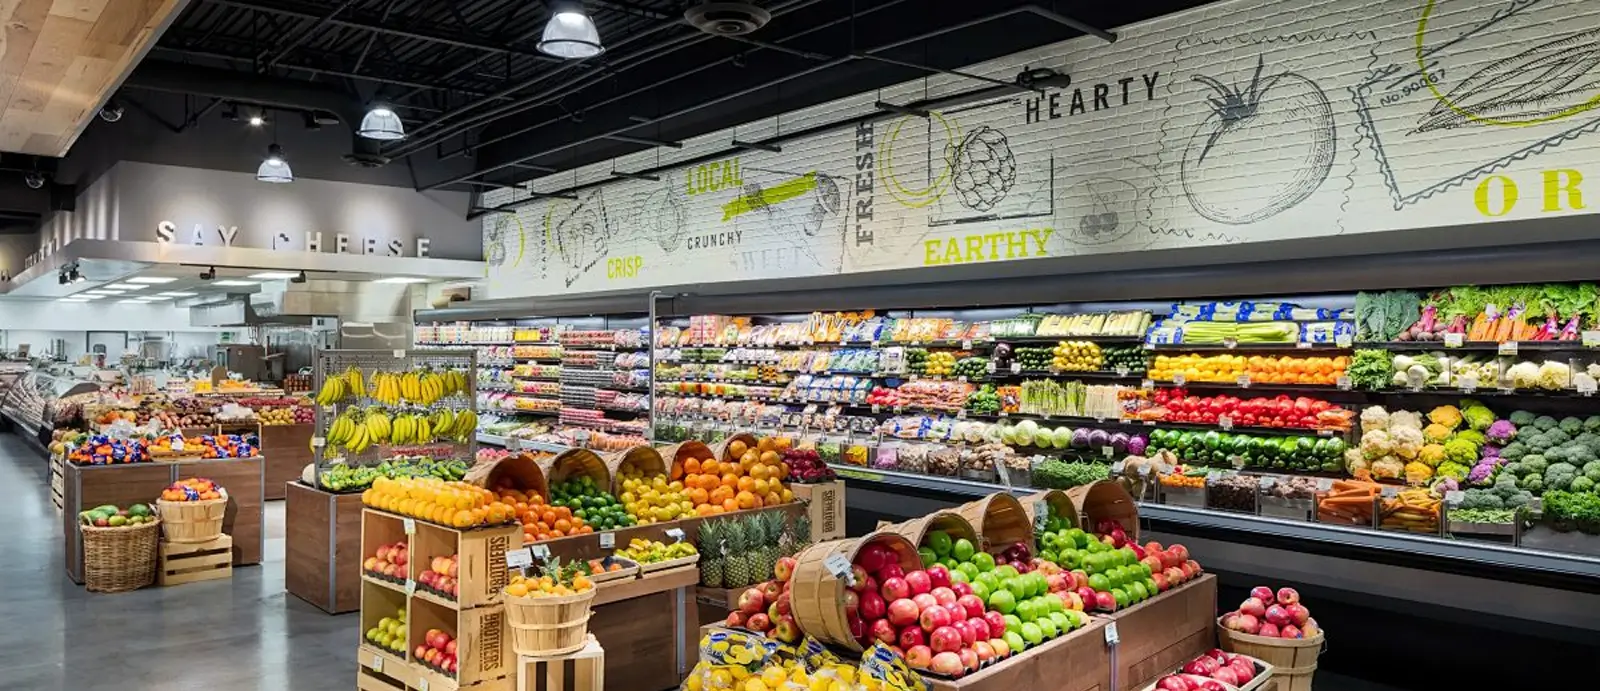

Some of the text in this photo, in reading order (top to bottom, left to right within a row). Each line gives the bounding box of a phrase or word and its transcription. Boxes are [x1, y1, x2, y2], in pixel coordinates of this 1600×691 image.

[1026, 71, 1159, 125] HEARTY
[686, 157, 743, 195] LOCAL
[856, 121, 874, 248] FRESH
[156, 220, 430, 258] SAY CHEESE
[687, 230, 743, 250] CRUNCHY
[924, 228, 1054, 266] EARTHY
[607, 255, 643, 280] CRISP
[484, 612, 500, 672] BROTHERS
